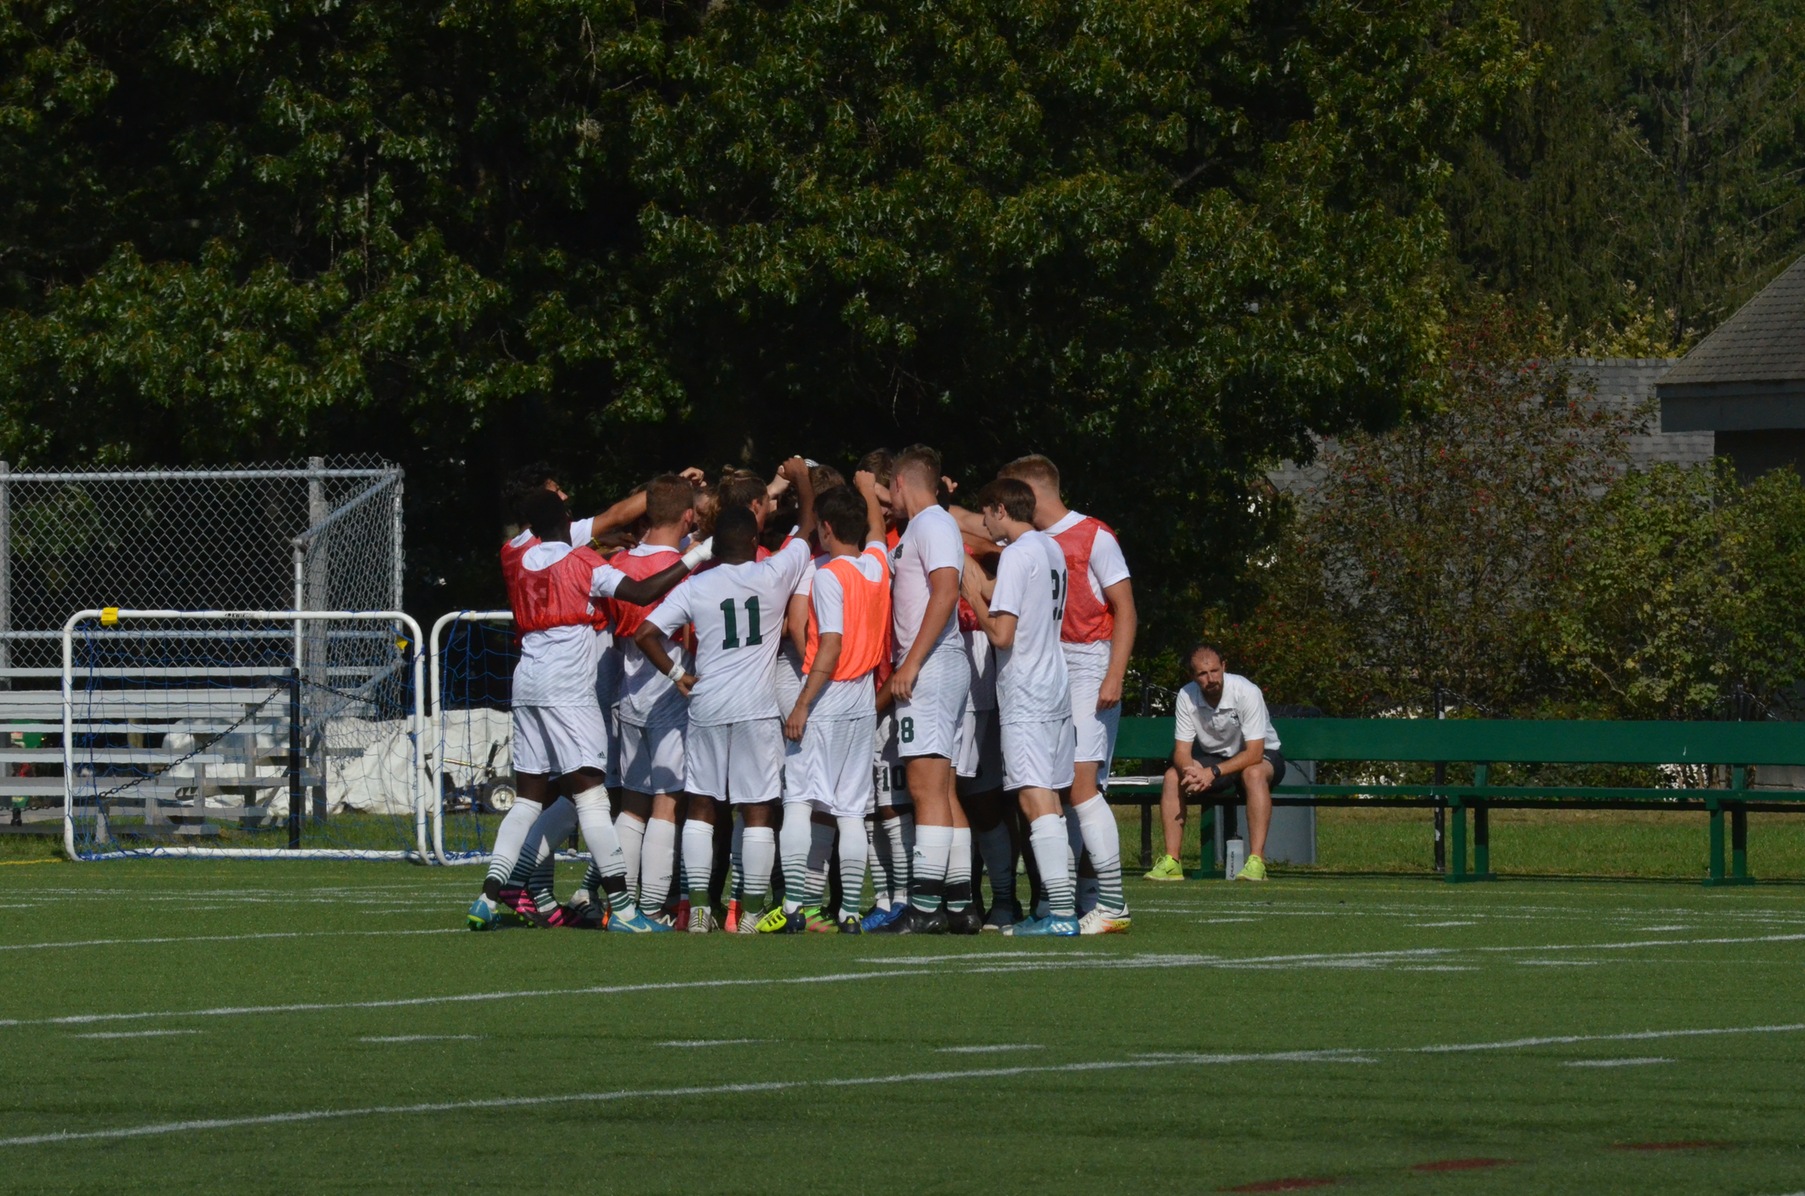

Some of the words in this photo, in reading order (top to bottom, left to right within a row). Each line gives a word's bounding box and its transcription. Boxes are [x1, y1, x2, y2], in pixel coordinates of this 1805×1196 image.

[720, 595, 764, 650] 11
[897, 716, 914, 744] 8
[882, 765, 907, 792] 10
